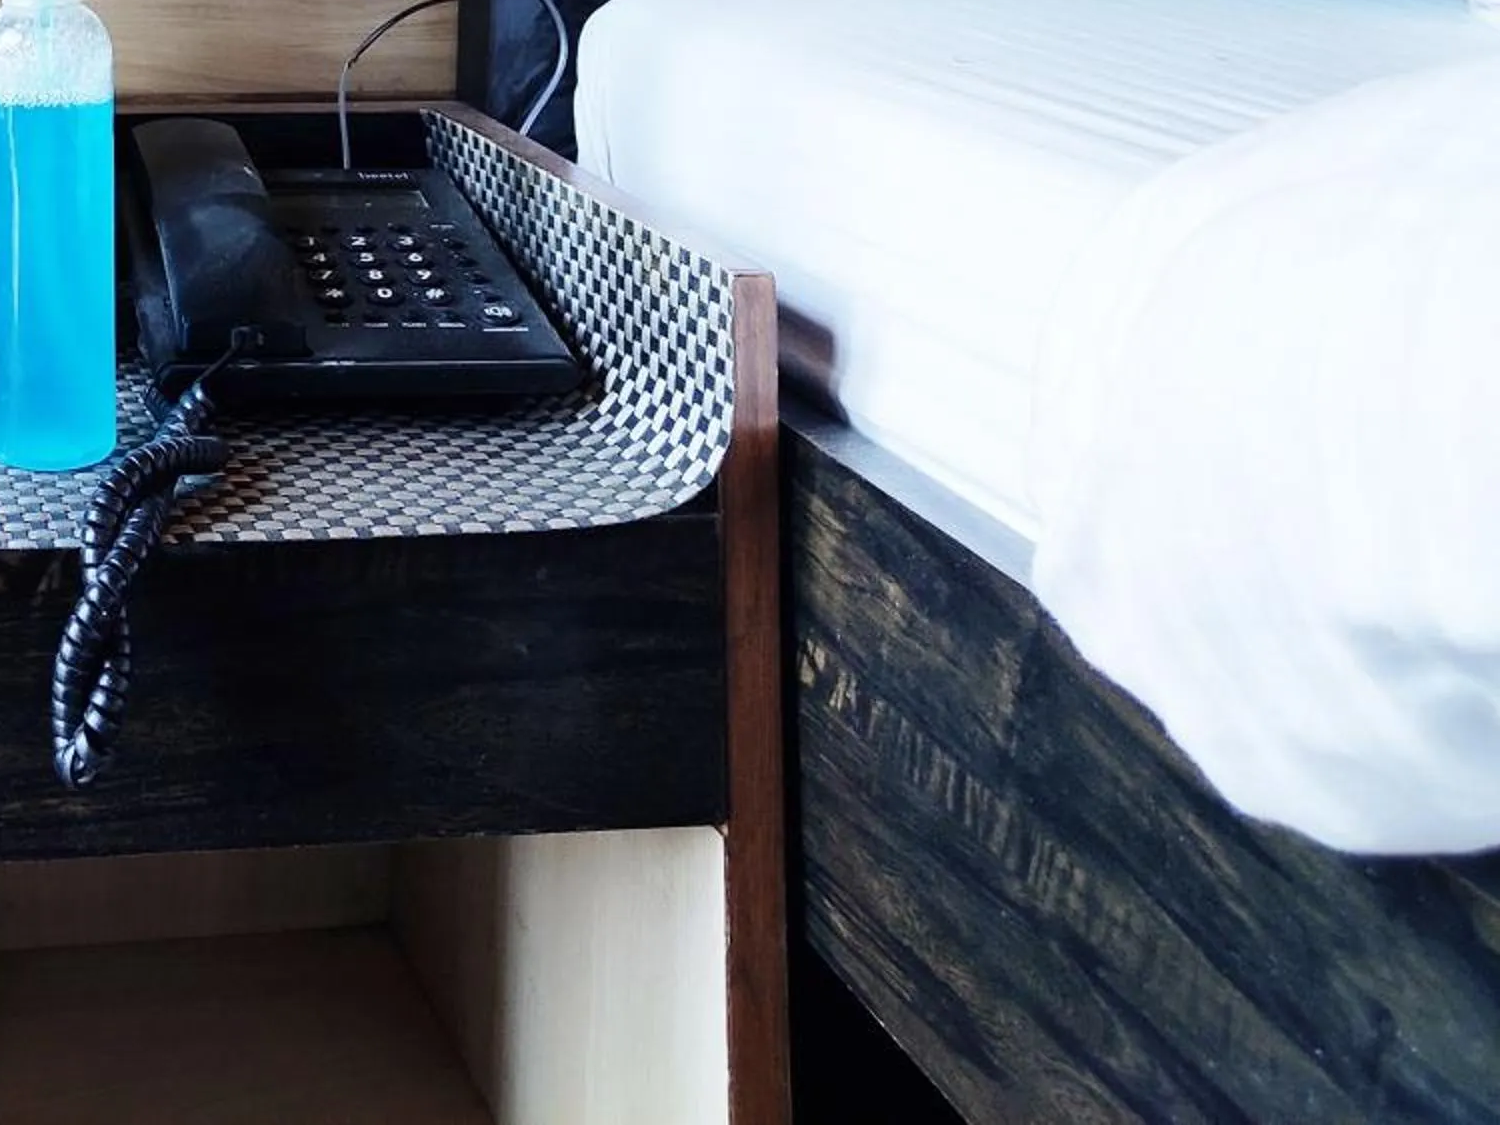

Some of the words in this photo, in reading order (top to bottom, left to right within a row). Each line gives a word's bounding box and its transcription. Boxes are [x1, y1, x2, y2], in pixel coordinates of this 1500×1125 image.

[351, 236, 366, 246] 2
[399, 236, 414, 246] 3
[313, 253, 326, 262] 4
[360, 252, 374, 262] 5
[408, 252, 423, 262] 6
[369, 269, 383, 280] 8
[417, 269, 432, 280] 9
[377, 287, 393, 298] 0
